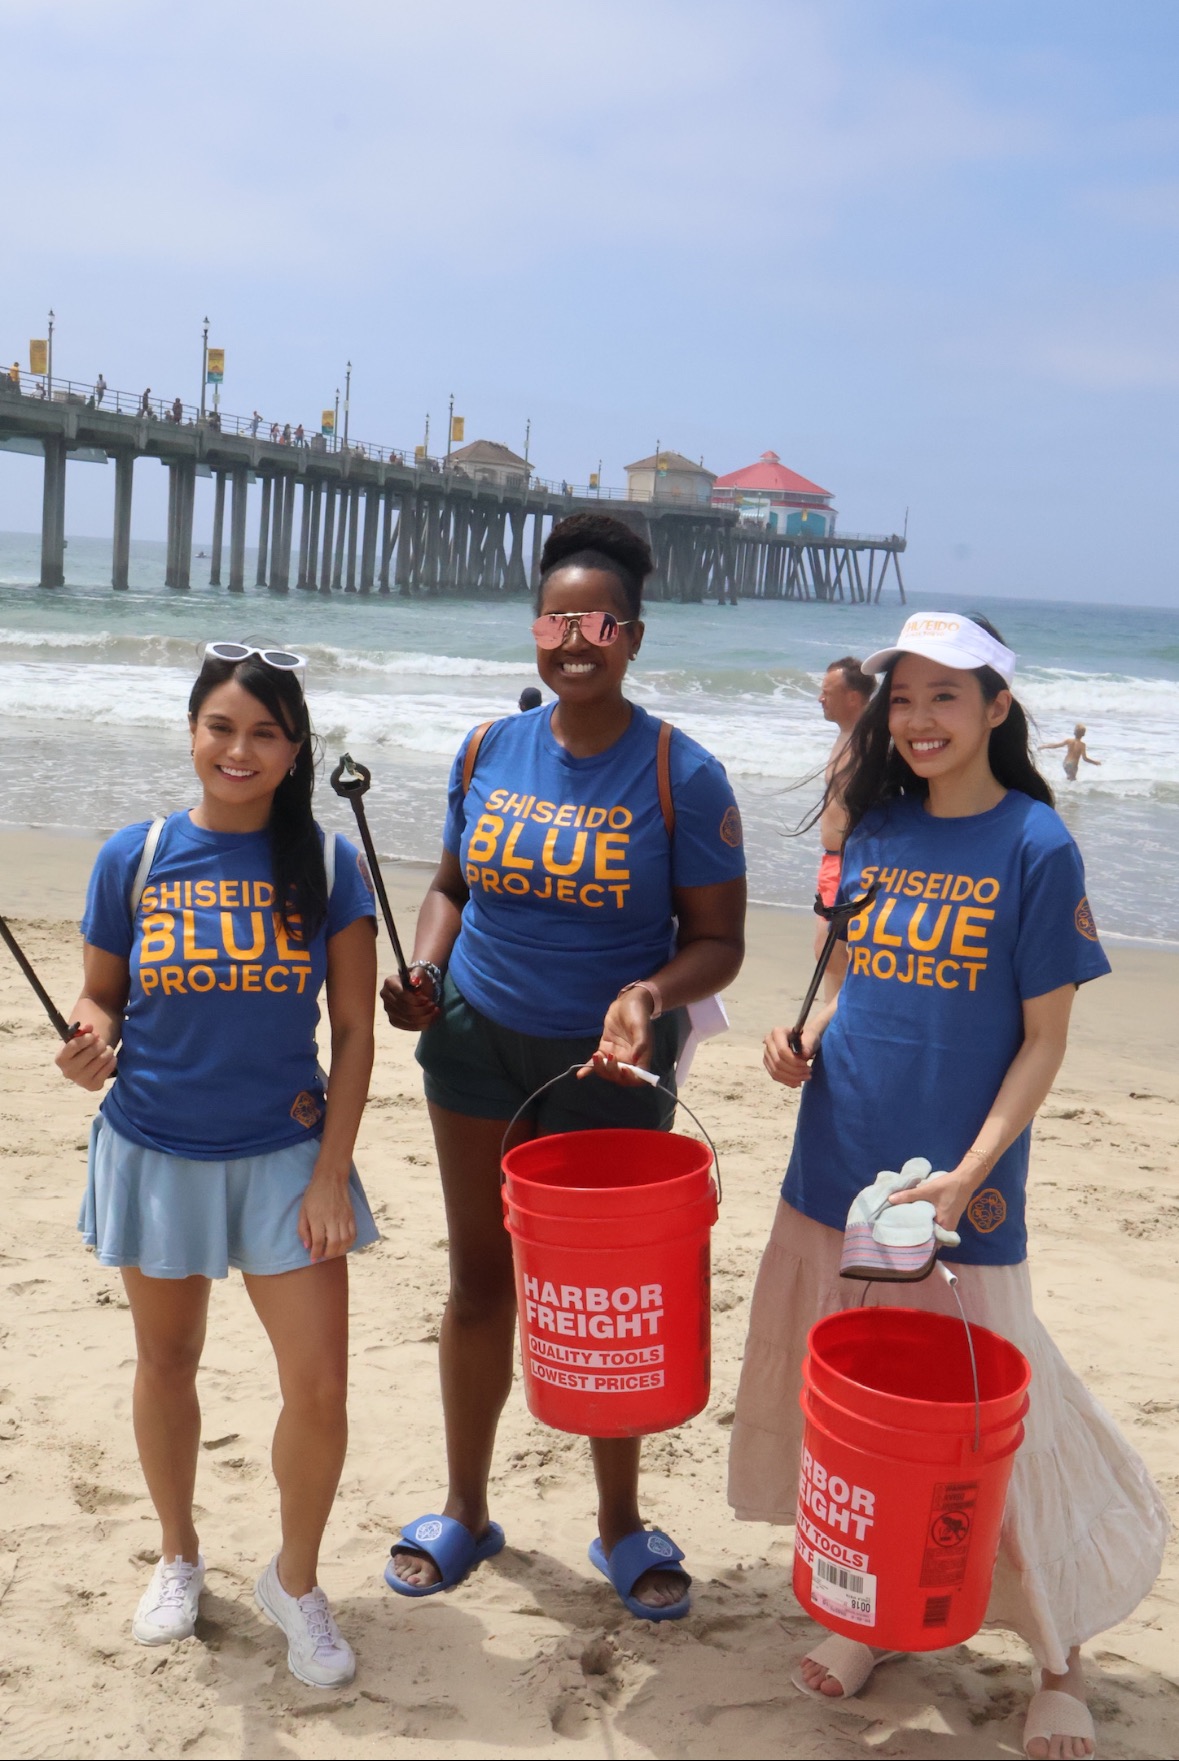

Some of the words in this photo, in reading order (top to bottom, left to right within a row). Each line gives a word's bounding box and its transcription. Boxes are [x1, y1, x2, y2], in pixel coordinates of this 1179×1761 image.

[485, 789, 633, 830] SHISEIDO
[467, 813, 630, 881] BLUE
[141, 880, 297, 913] SHISEID
[466, 863, 631, 909] PROJECT
[860, 866, 1000, 904] SHISEIDO
[139, 909, 311, 964] BLUE
[847, 893, 995, 958] BLUE
[139, 964, 312, 996] PROJECT
[848, 946, 987, 992] ROJECT
[523, 1272, 663, 1312] HARBOR
[525, 1298, 664, 1339] FREIGHT
[530, 1338, 593, 1365] QUALITY
[599, 1349, 660, 1366] TOOLS
[532, 1362, 588, 1389] LOWEST
[594, 1372, 661, 1390] PRICES
[802, 1447, 876, 1517] RBOR
[799, 1474, 874, 1541] EIGHT
[814, 1530, 863, 1568] TOOLS
